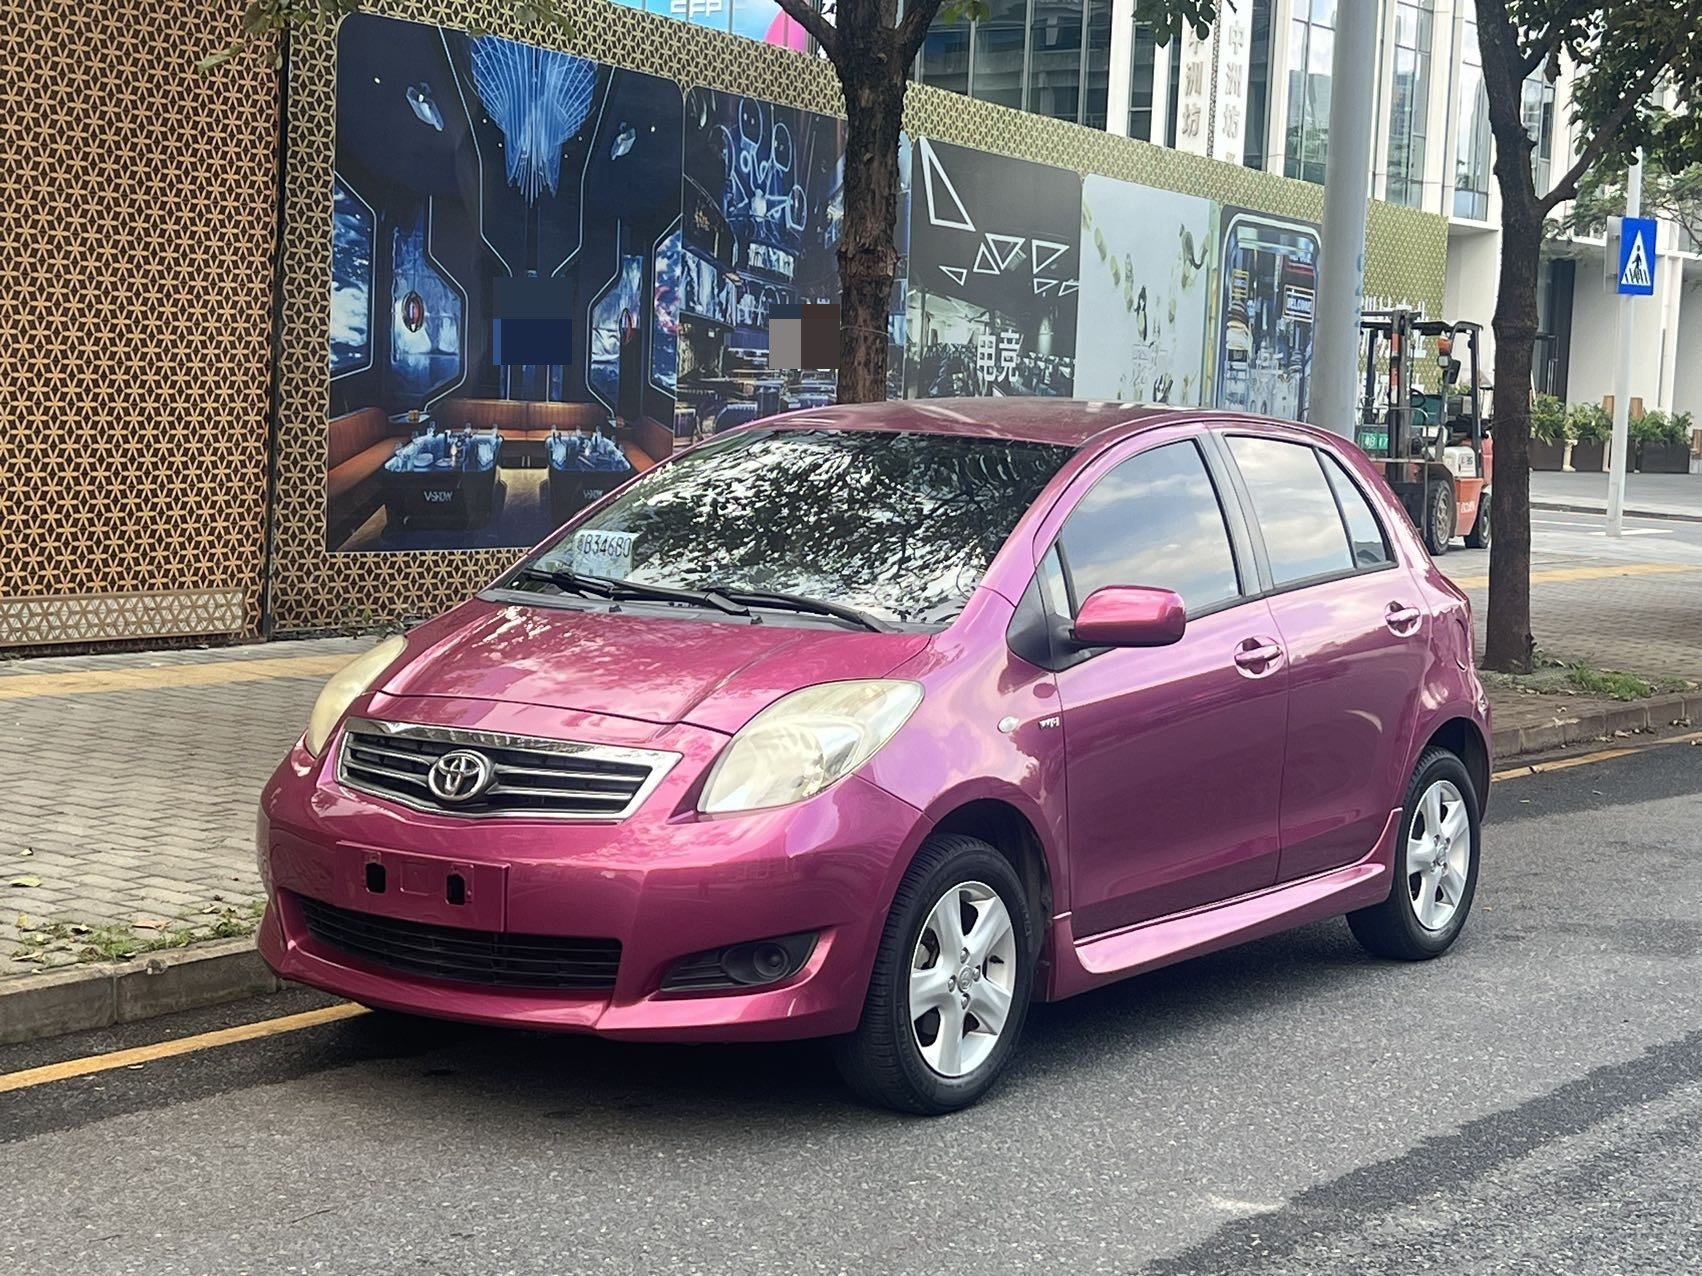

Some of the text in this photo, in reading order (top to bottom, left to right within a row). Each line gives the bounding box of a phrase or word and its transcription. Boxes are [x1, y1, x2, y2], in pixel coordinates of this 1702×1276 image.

[1222, 20, 1245, 139] 中洲坊
[977, 326, 1020, 382] 电竞
